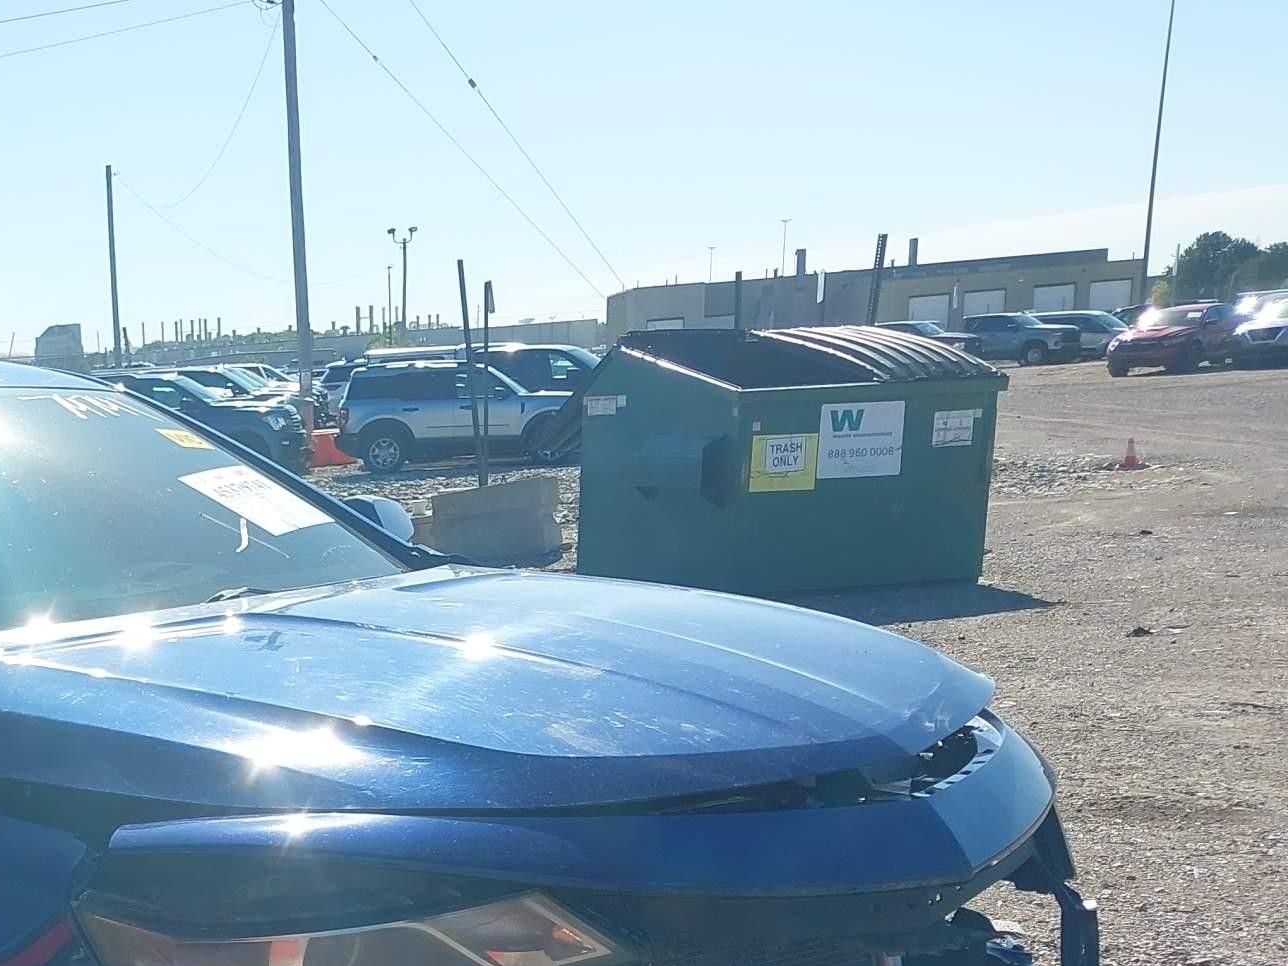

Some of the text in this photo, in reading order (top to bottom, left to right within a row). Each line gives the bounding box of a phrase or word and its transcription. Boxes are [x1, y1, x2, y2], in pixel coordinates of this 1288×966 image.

[830, 408, 865, 433] W
[770, 441, 803, 455] TRASH
[827, 448, 846, 459] 888
[772, 455, 799, 468] ONLY
